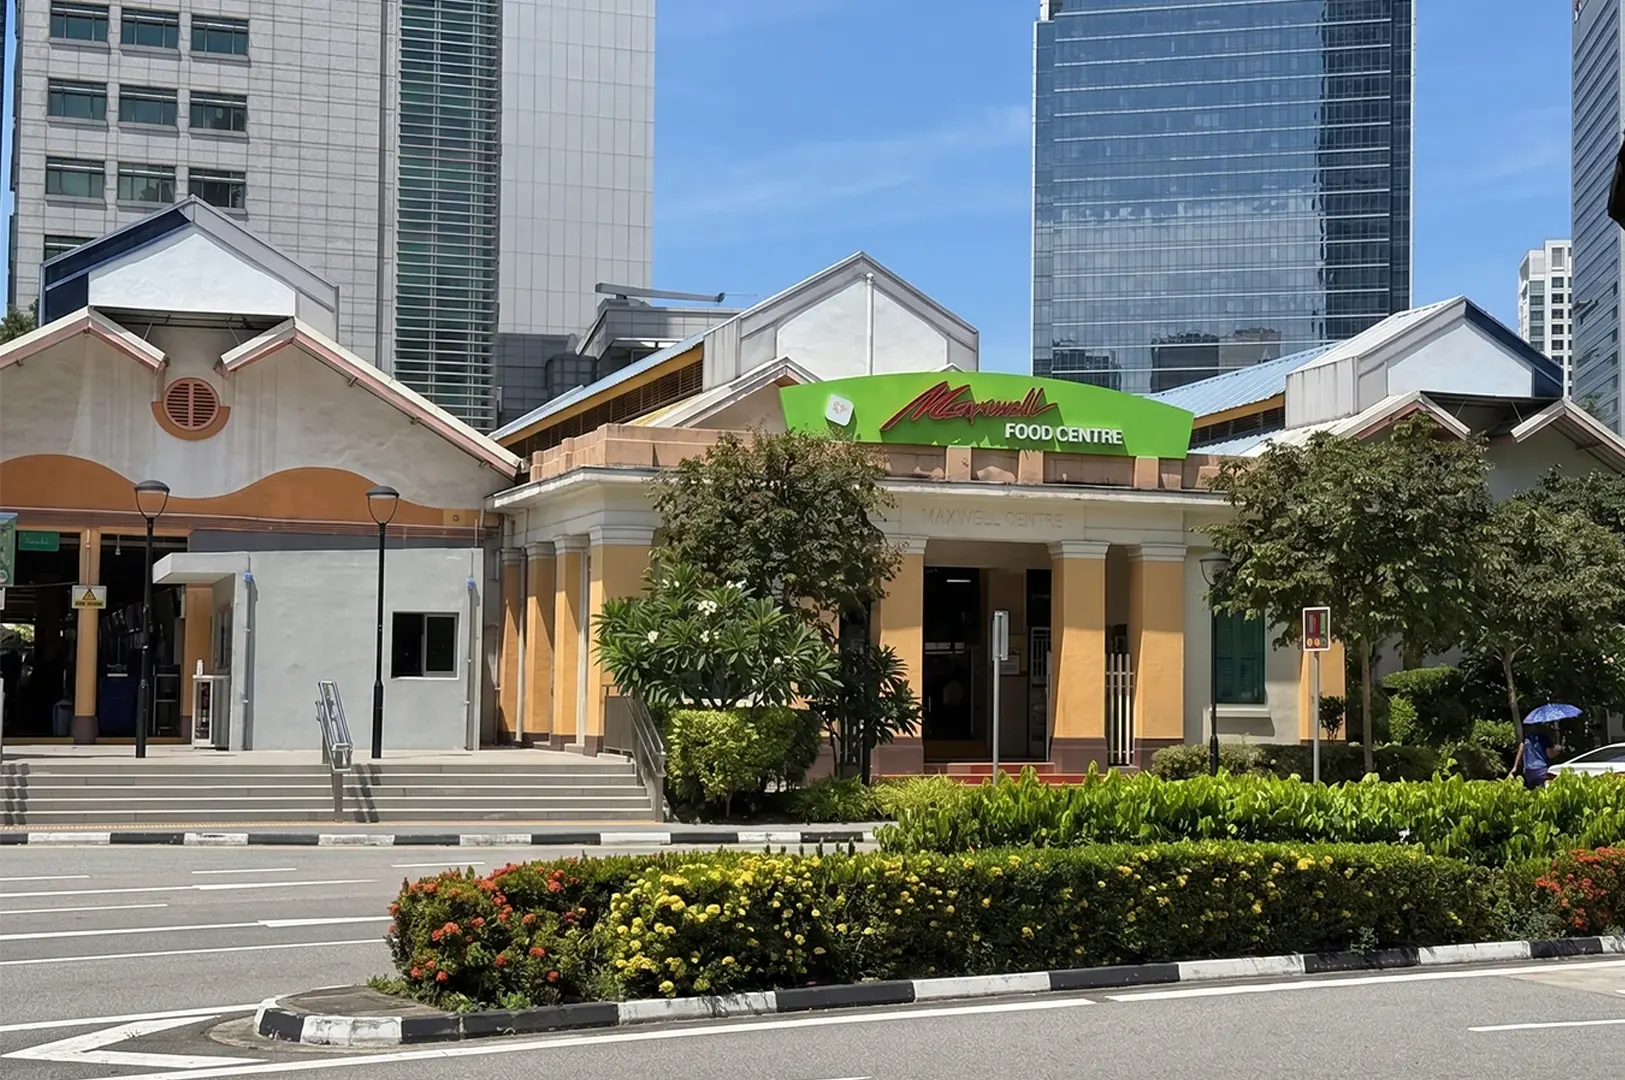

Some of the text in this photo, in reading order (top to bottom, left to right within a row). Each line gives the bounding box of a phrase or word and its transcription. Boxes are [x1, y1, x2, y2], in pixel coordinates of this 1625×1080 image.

[880, 381, 1058, 431] Maxwell
[1005, 422, 1124, 445] FOOD CENTRE
[922, 508, 1064, 529] MAXWELL CENTRE
